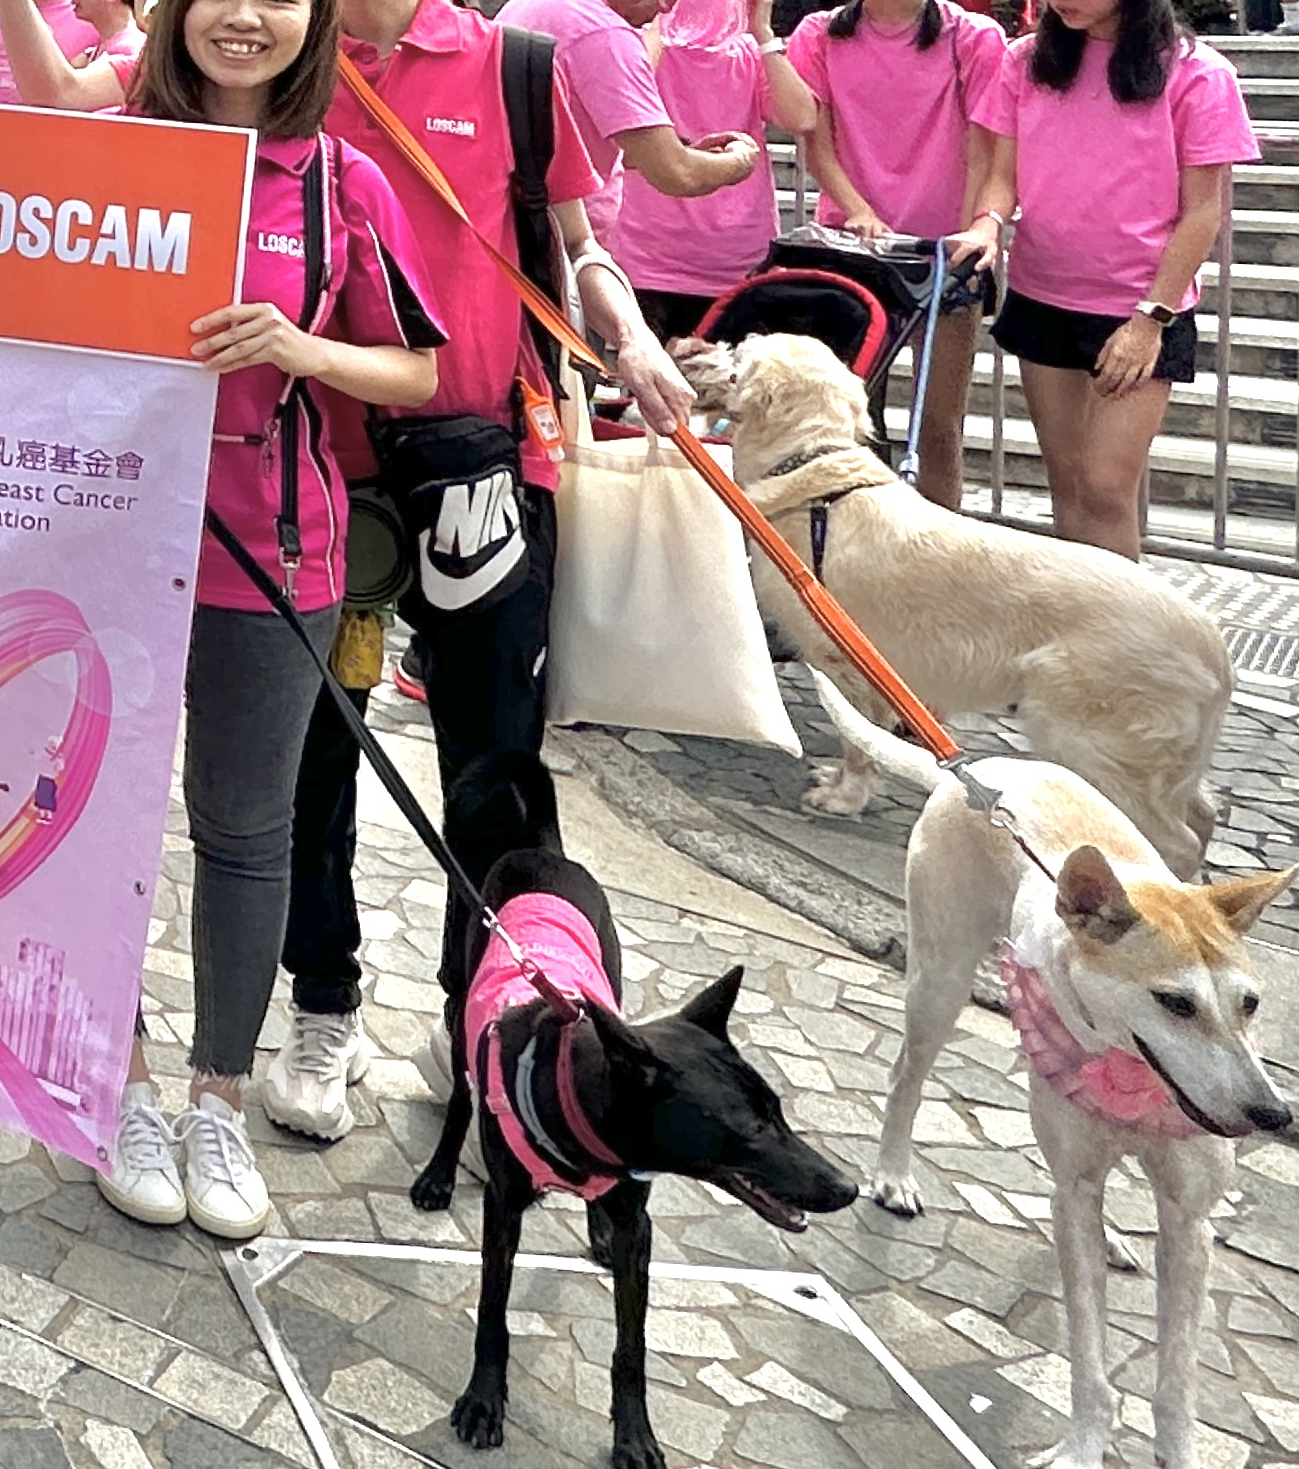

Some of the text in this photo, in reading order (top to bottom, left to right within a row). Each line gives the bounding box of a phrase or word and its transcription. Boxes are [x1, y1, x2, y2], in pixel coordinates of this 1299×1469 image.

[425, 117, 476, 137] LOSCAM
[258, 231, 305, 258] LOSCA
[53, 485, 139, 513] Cancer
